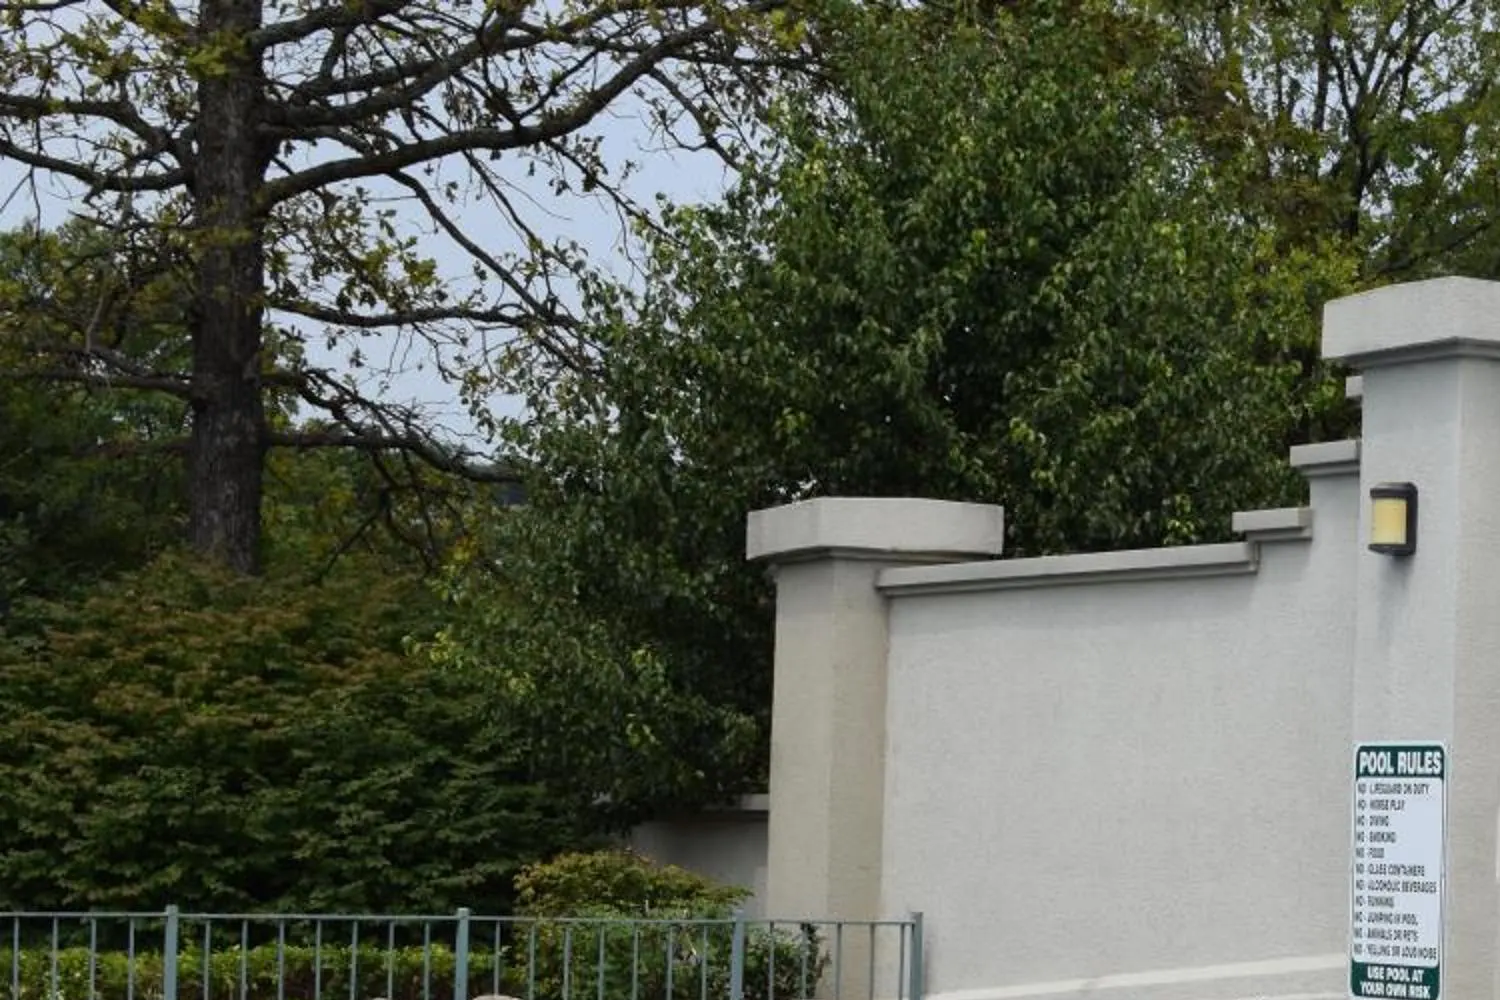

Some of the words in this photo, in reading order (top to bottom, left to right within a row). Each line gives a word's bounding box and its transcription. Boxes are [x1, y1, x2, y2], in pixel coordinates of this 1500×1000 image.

[1359, 751, 1394, 774] POOL
[1398, 751, 1441, 774] RULES
[1358, 784, 1366, 794] NO
[1413, 784, 1430, 794] DUTY
[1358, 800, 1366, 811] NO
[1390, 800, 1405, 811] PLAY
[1357, 815, 1365, 826] NO
[1356, 864, 1364, 874] NO
[1368, 864, 1386, 875] GLASS
[1388, 864, 1424, 876] CONTAINERS
[1356, 880, 1364, 890] NO
[1368, 880, 1400, 892] ALCOHOLIC
[1402, 881, 1437, 893] BEVERAGES
[1402, 914, 1417, 925] POOL
[1403, 930, 1418, 942] PETS
[1367, 944, 1390, 956] YELLING
[1402, 946, 1416, 958] LOUD
[1418, 947, 1437, 959] NOISE
[1367, 966, 1384, 980] USE
[1386, 968, 1410, 982] POOL
[1411, 969, 1424, 982] AT
[1360, 980, 1384, 996] YOUR
[1386, 983, 1407, 997] OWN
[1408, 985, 1431, 999] RISK
